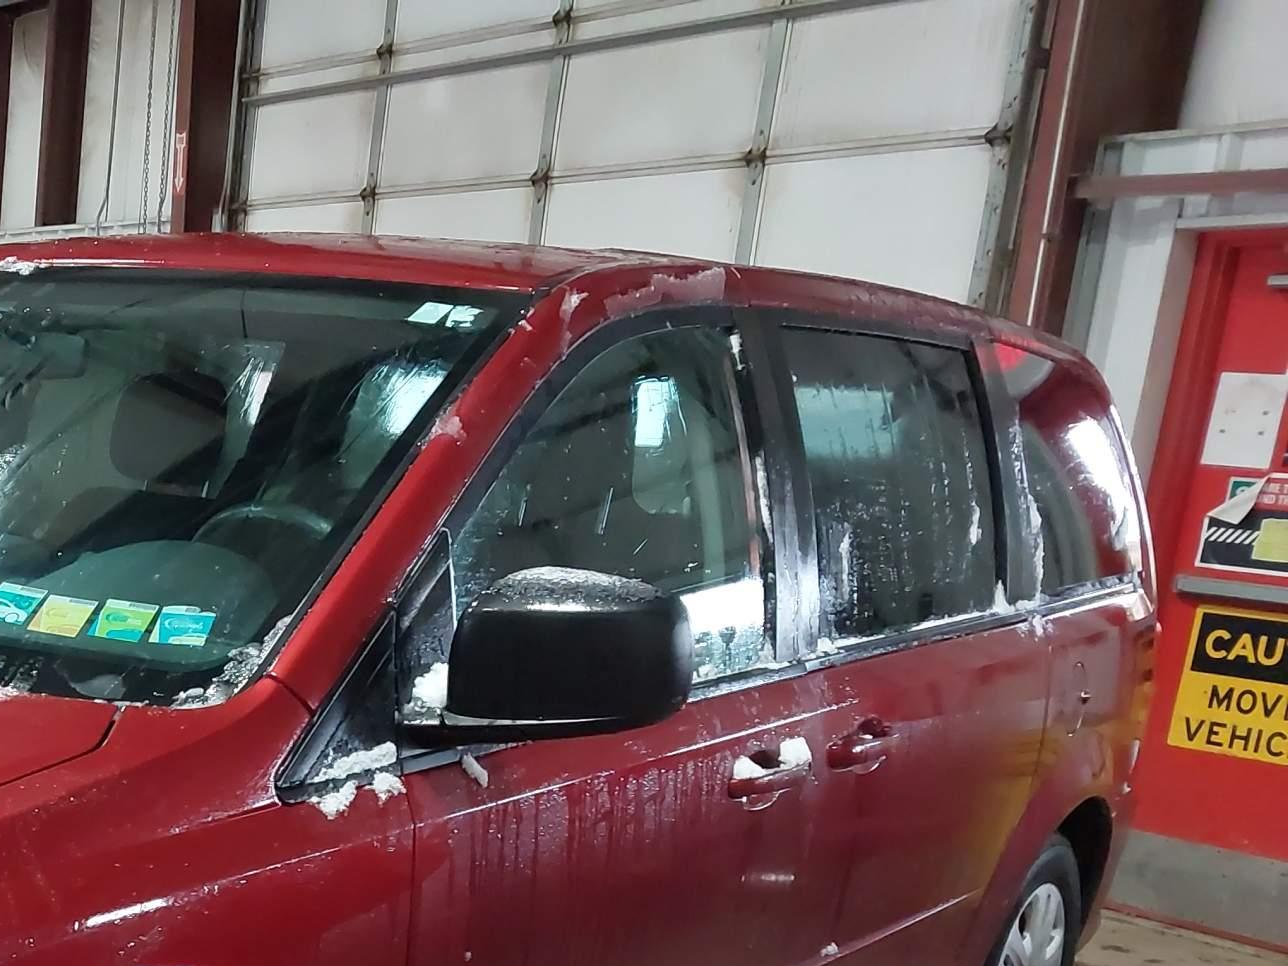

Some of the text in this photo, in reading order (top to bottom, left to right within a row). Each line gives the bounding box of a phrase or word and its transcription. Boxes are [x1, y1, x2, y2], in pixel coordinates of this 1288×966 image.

[1205, 629, 1288, 666] CAU
[1208, 685, 1288, 721] MOV
[1185, 717, 1288, 758] VEHIC
